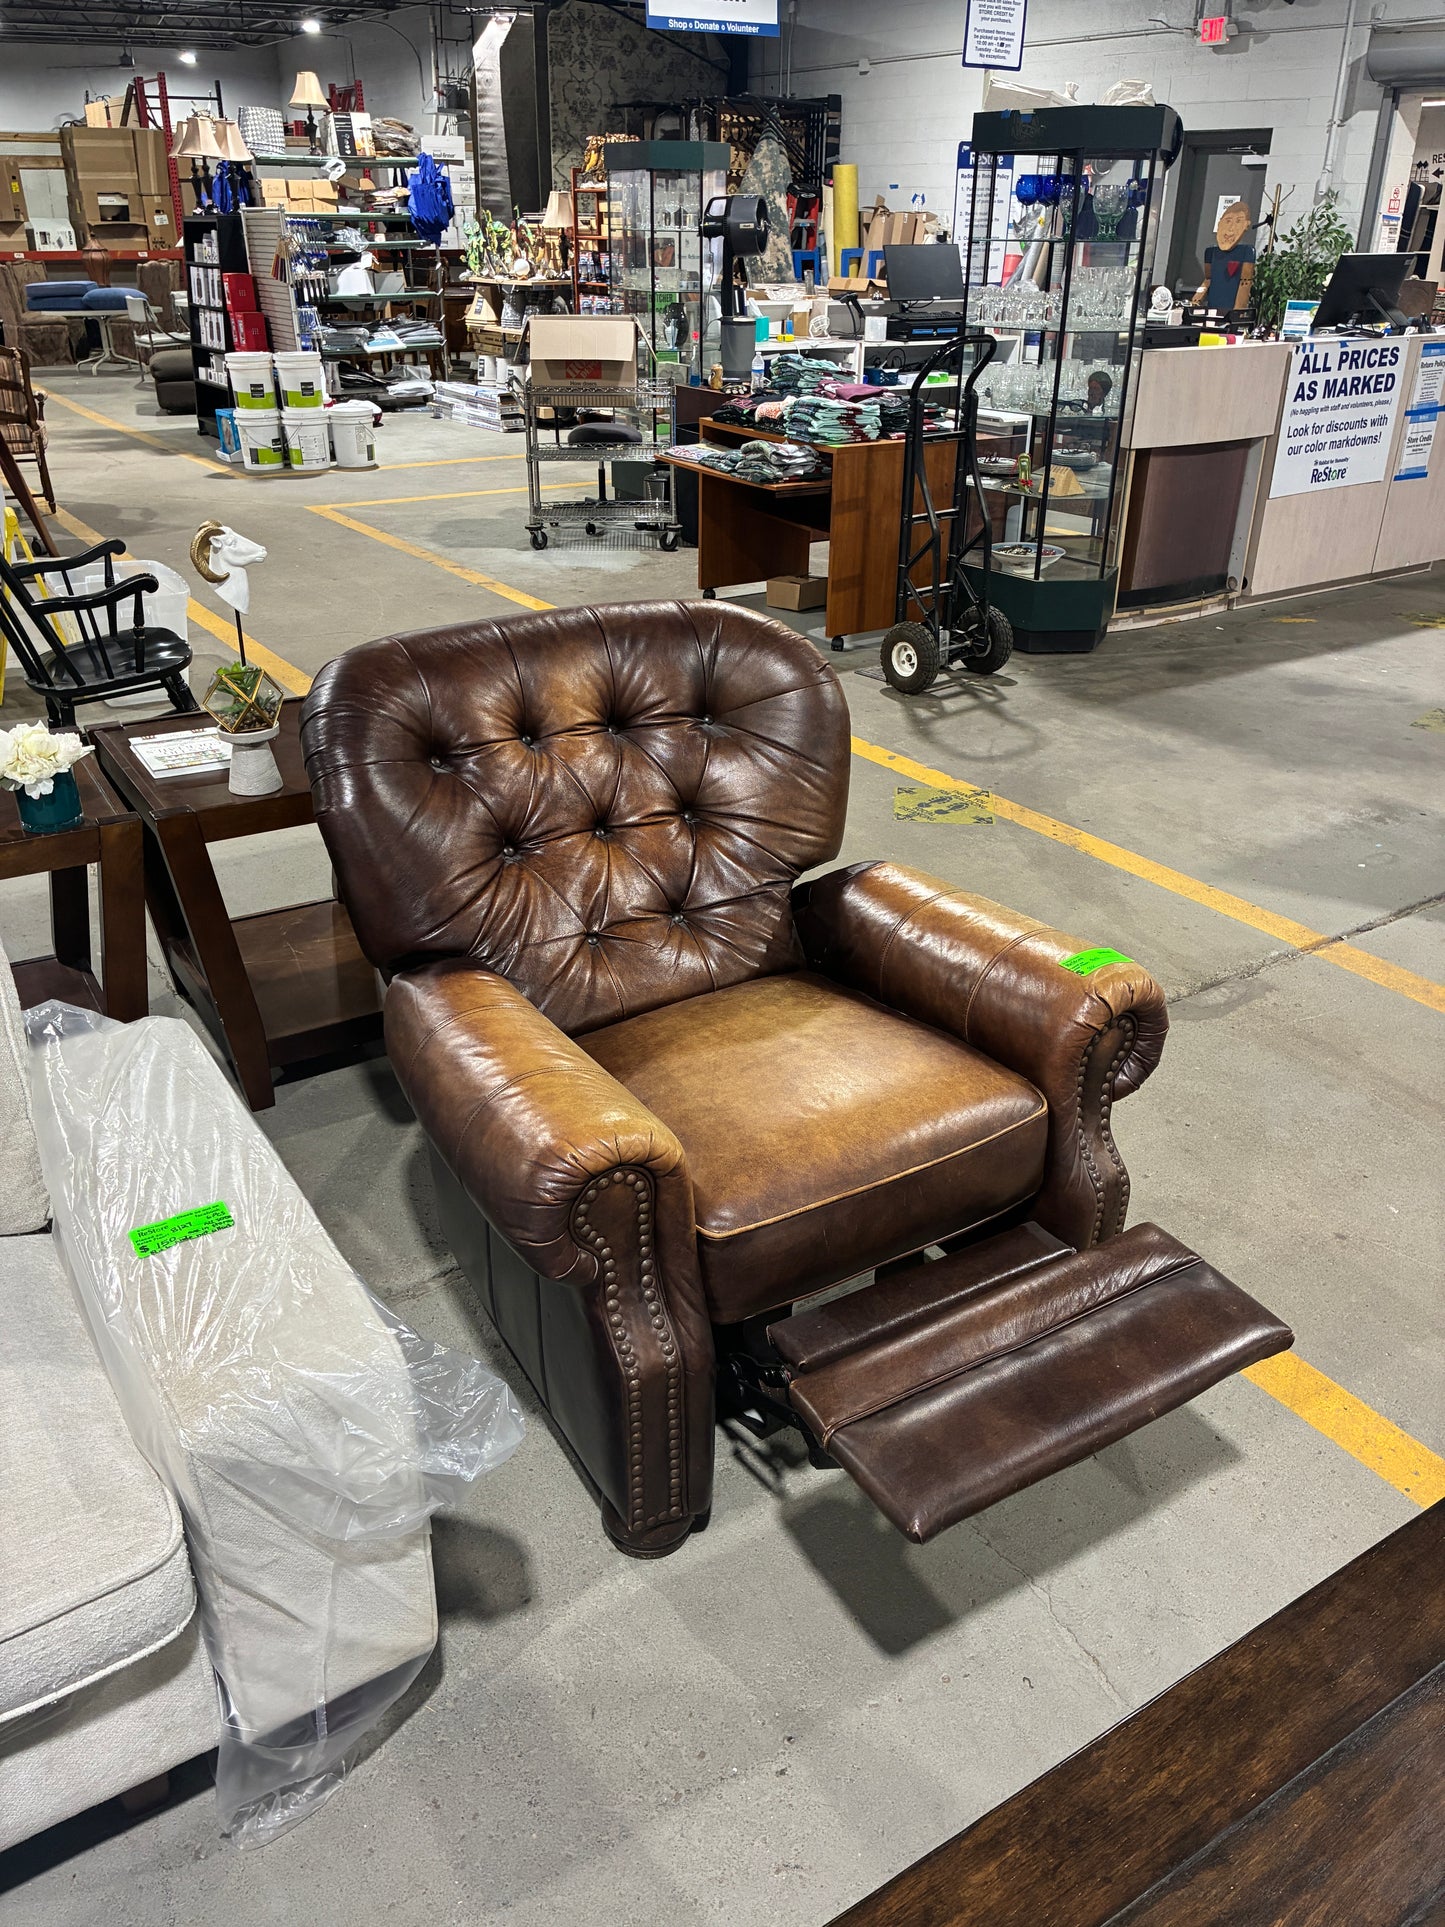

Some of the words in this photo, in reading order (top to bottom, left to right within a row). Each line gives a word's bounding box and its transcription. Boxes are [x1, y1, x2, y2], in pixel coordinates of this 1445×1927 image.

[668, 19, 687, 30] Shop
[694, 21, 719, 31] Donate
[726, 23, 759, 33] Volunteer
[1201, 17, 1225, 42] EXIT
[1298, 353, 1332, 375] ALL
[1337, 346, 1400, 371] PRICES
[1293, 381, 1318, 402] AS
[1322, 373, 1396, 399] MARKED
[1290, 408, 1300, 417] (No
[1300, 407, 1319, 416] haggling
[1330, 403, 1340, 411] staff
[1350, 399, 1374, 409] volunteers,
[1287, 424, 1309, 438] Look
[1311, 423, 1324, 435] for
[1326, 417, 1367, 433] discounts
[1370, 414, 1388, 427] with
[1287, 446, 1303, 455] our
[1304, 440, 1327, 453] color
[1328, 432, 1382, 450] markdowns!
[1419, 435, 1432, 443] Credit
[1310, 466, 1347, 483] ReStore
[138, 1225, 169, 1238] ReStore
[139, 1245, 150, 1253] $
